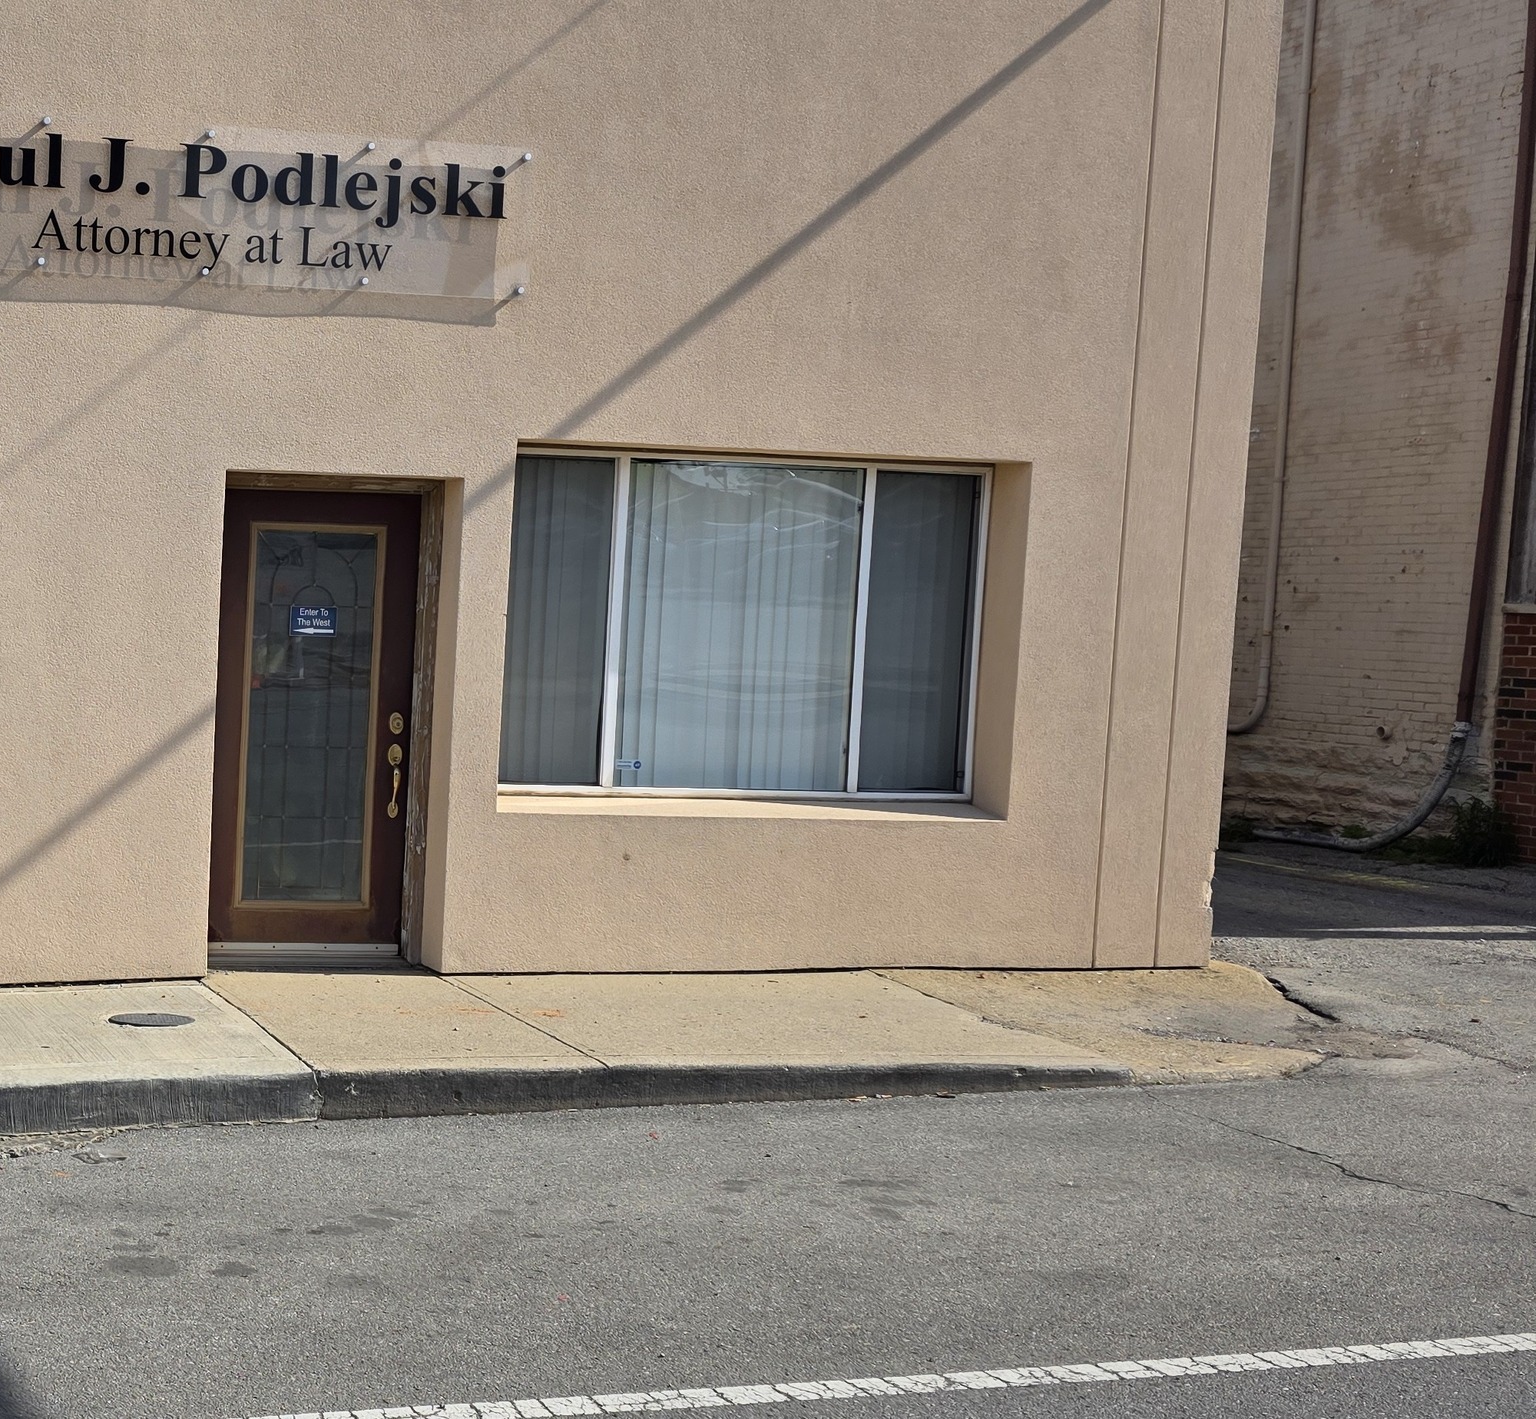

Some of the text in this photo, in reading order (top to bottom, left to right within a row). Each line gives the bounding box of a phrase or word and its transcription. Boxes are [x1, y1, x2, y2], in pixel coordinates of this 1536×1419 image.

[89, 137, 150, 195] J.
[177, 143, 508, 229] Podlejski
[32, 208, 394, 272] Attorney at Law
[298, 618, 331, 627] The West
[300, 607, 329, 617] Enter To
